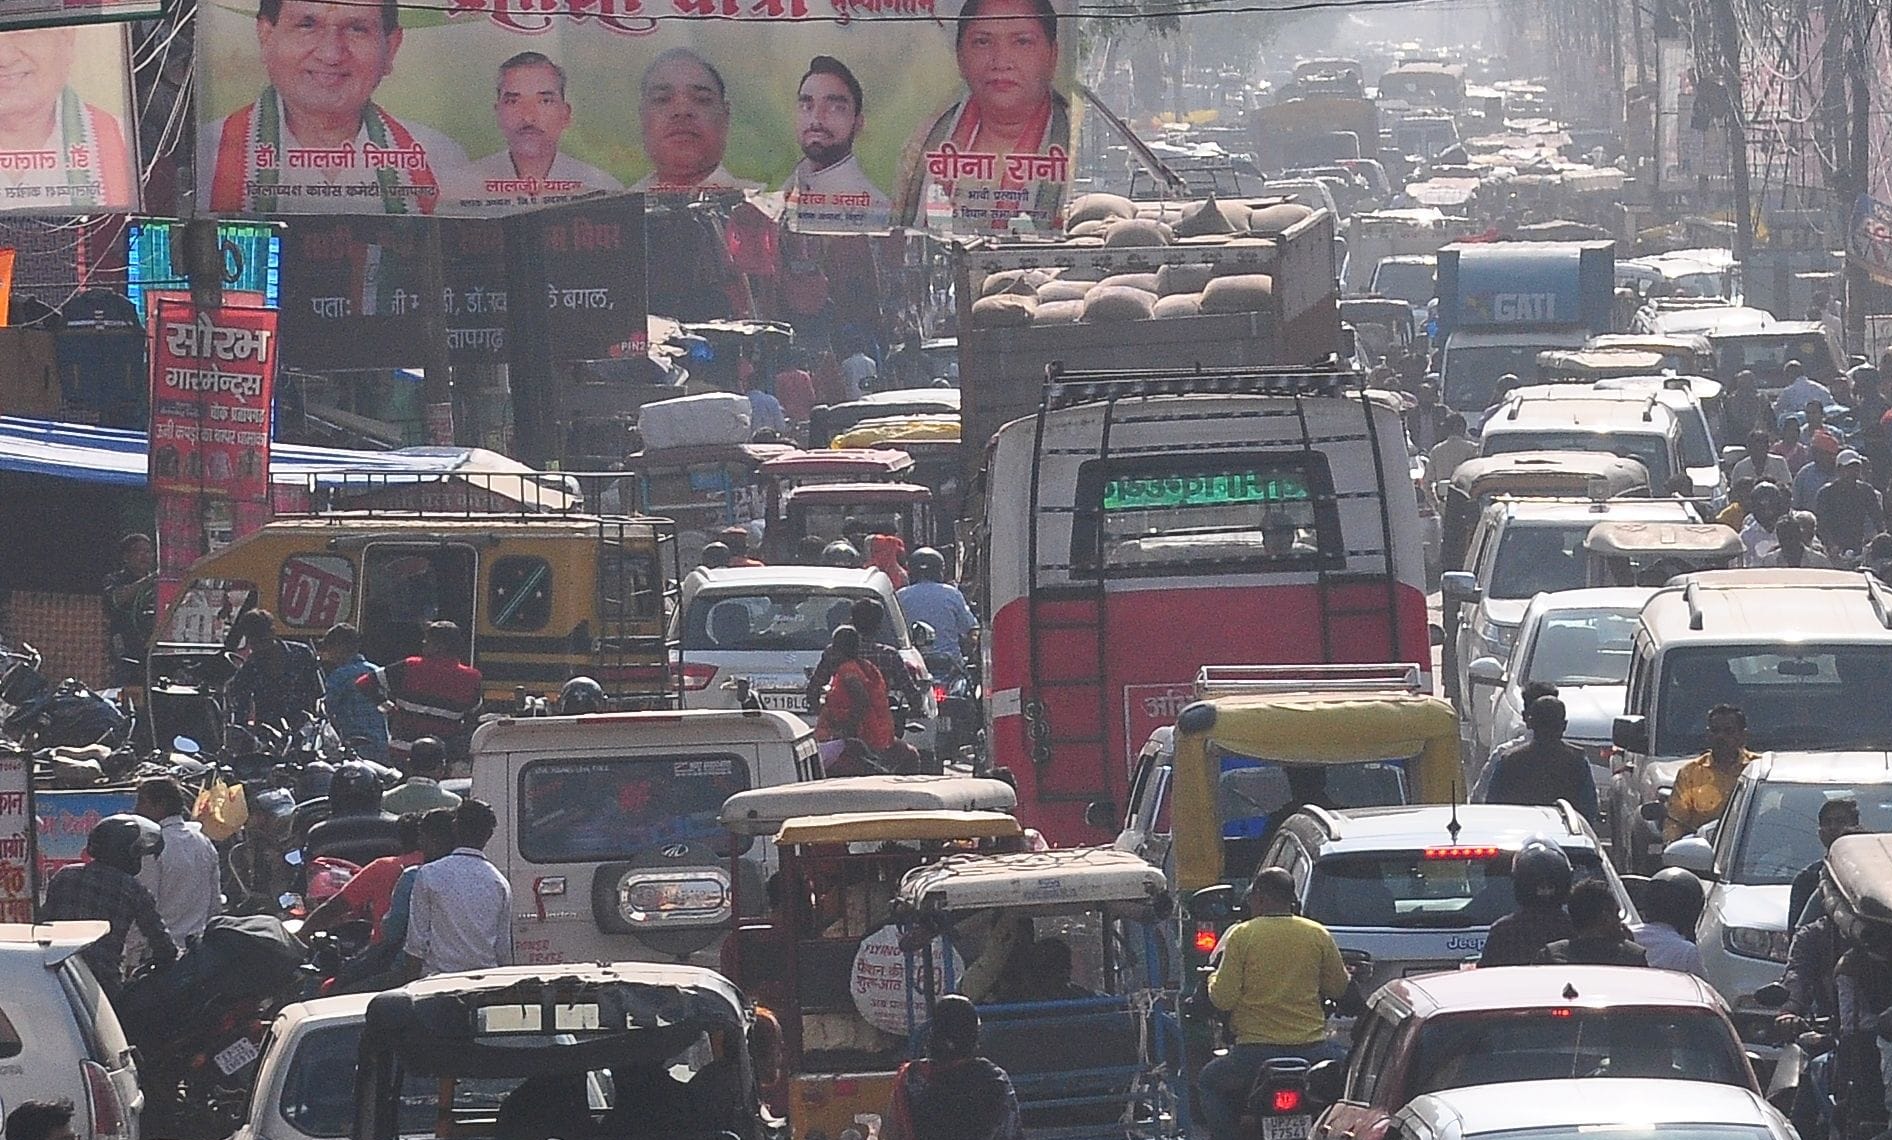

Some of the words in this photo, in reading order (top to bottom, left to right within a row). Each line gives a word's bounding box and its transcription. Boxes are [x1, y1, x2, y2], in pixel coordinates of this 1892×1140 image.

[288, 142, 355, 169] लालजी
[926, 143, 996, 180] बीना
[1006, 144, 1069, 182] रानी
[1494, 292, 1557, 321] GATI
[1447, 935, 1487, 952] Jeep
